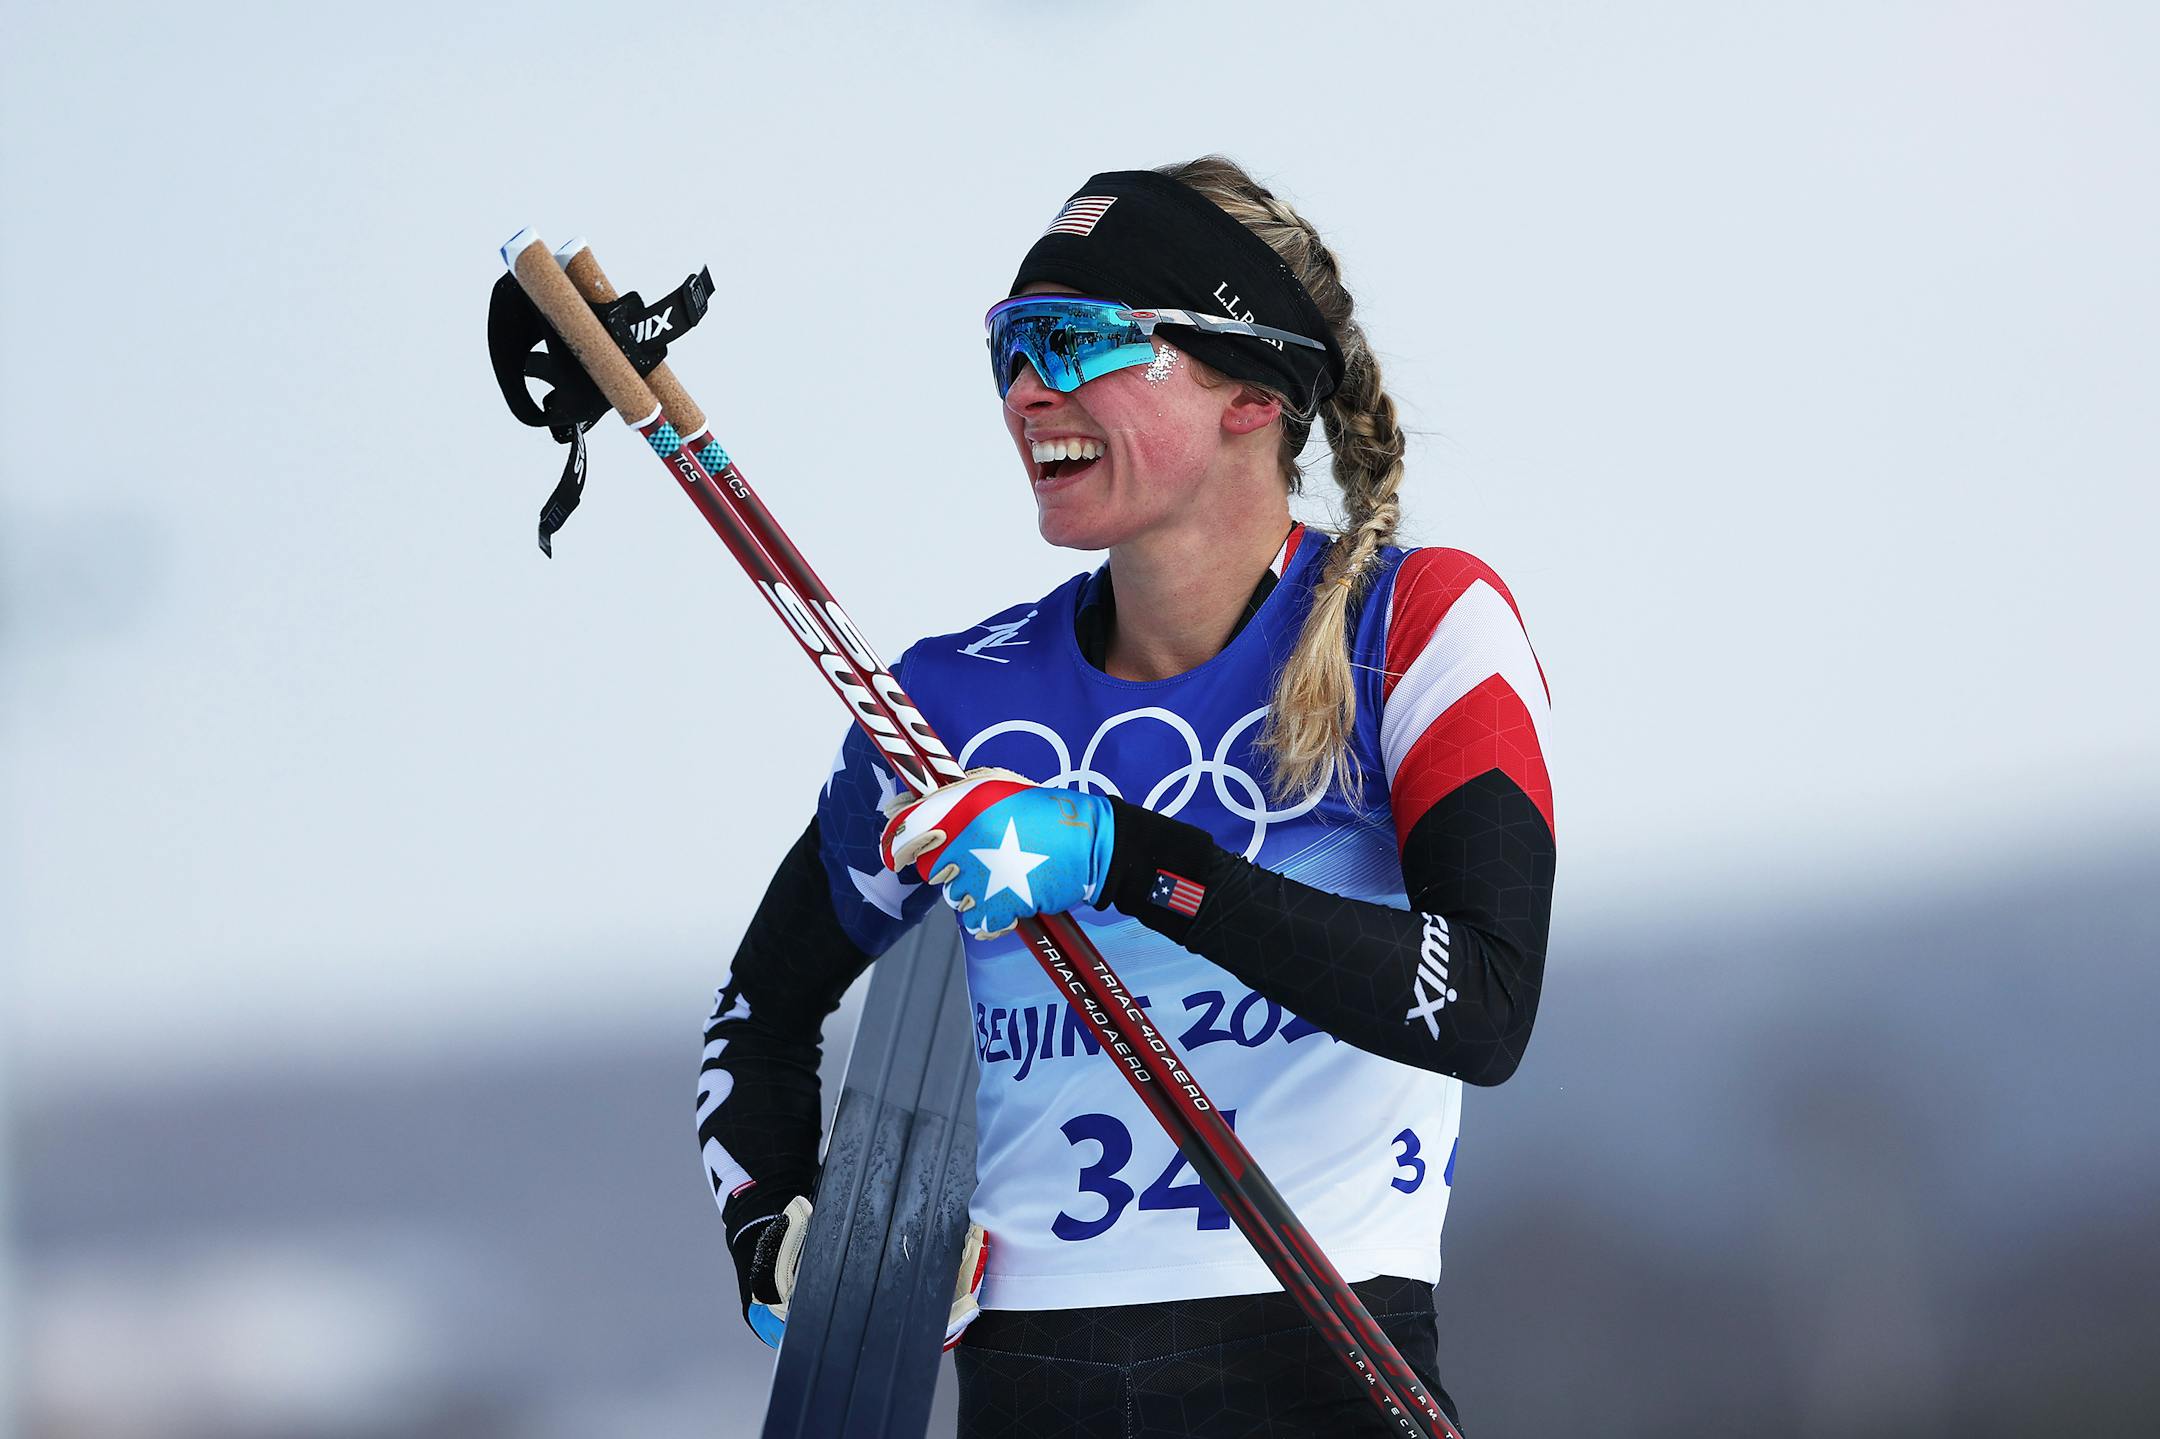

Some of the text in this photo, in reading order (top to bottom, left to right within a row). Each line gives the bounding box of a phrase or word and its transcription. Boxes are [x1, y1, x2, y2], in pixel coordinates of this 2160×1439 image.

[976, 996, 1152, 1082] BEIJIN
[1036, 935, 1151, 1083] TRIAC 4.0 AERO
[1093, 961, 1210, 1111] TRIAC 4.0 AERO
[1051, 1113, 1237, 1242] 34
[1390, 1128, 1458, 1194] 3
[1383, 1395, 1418, 1439] TECH
